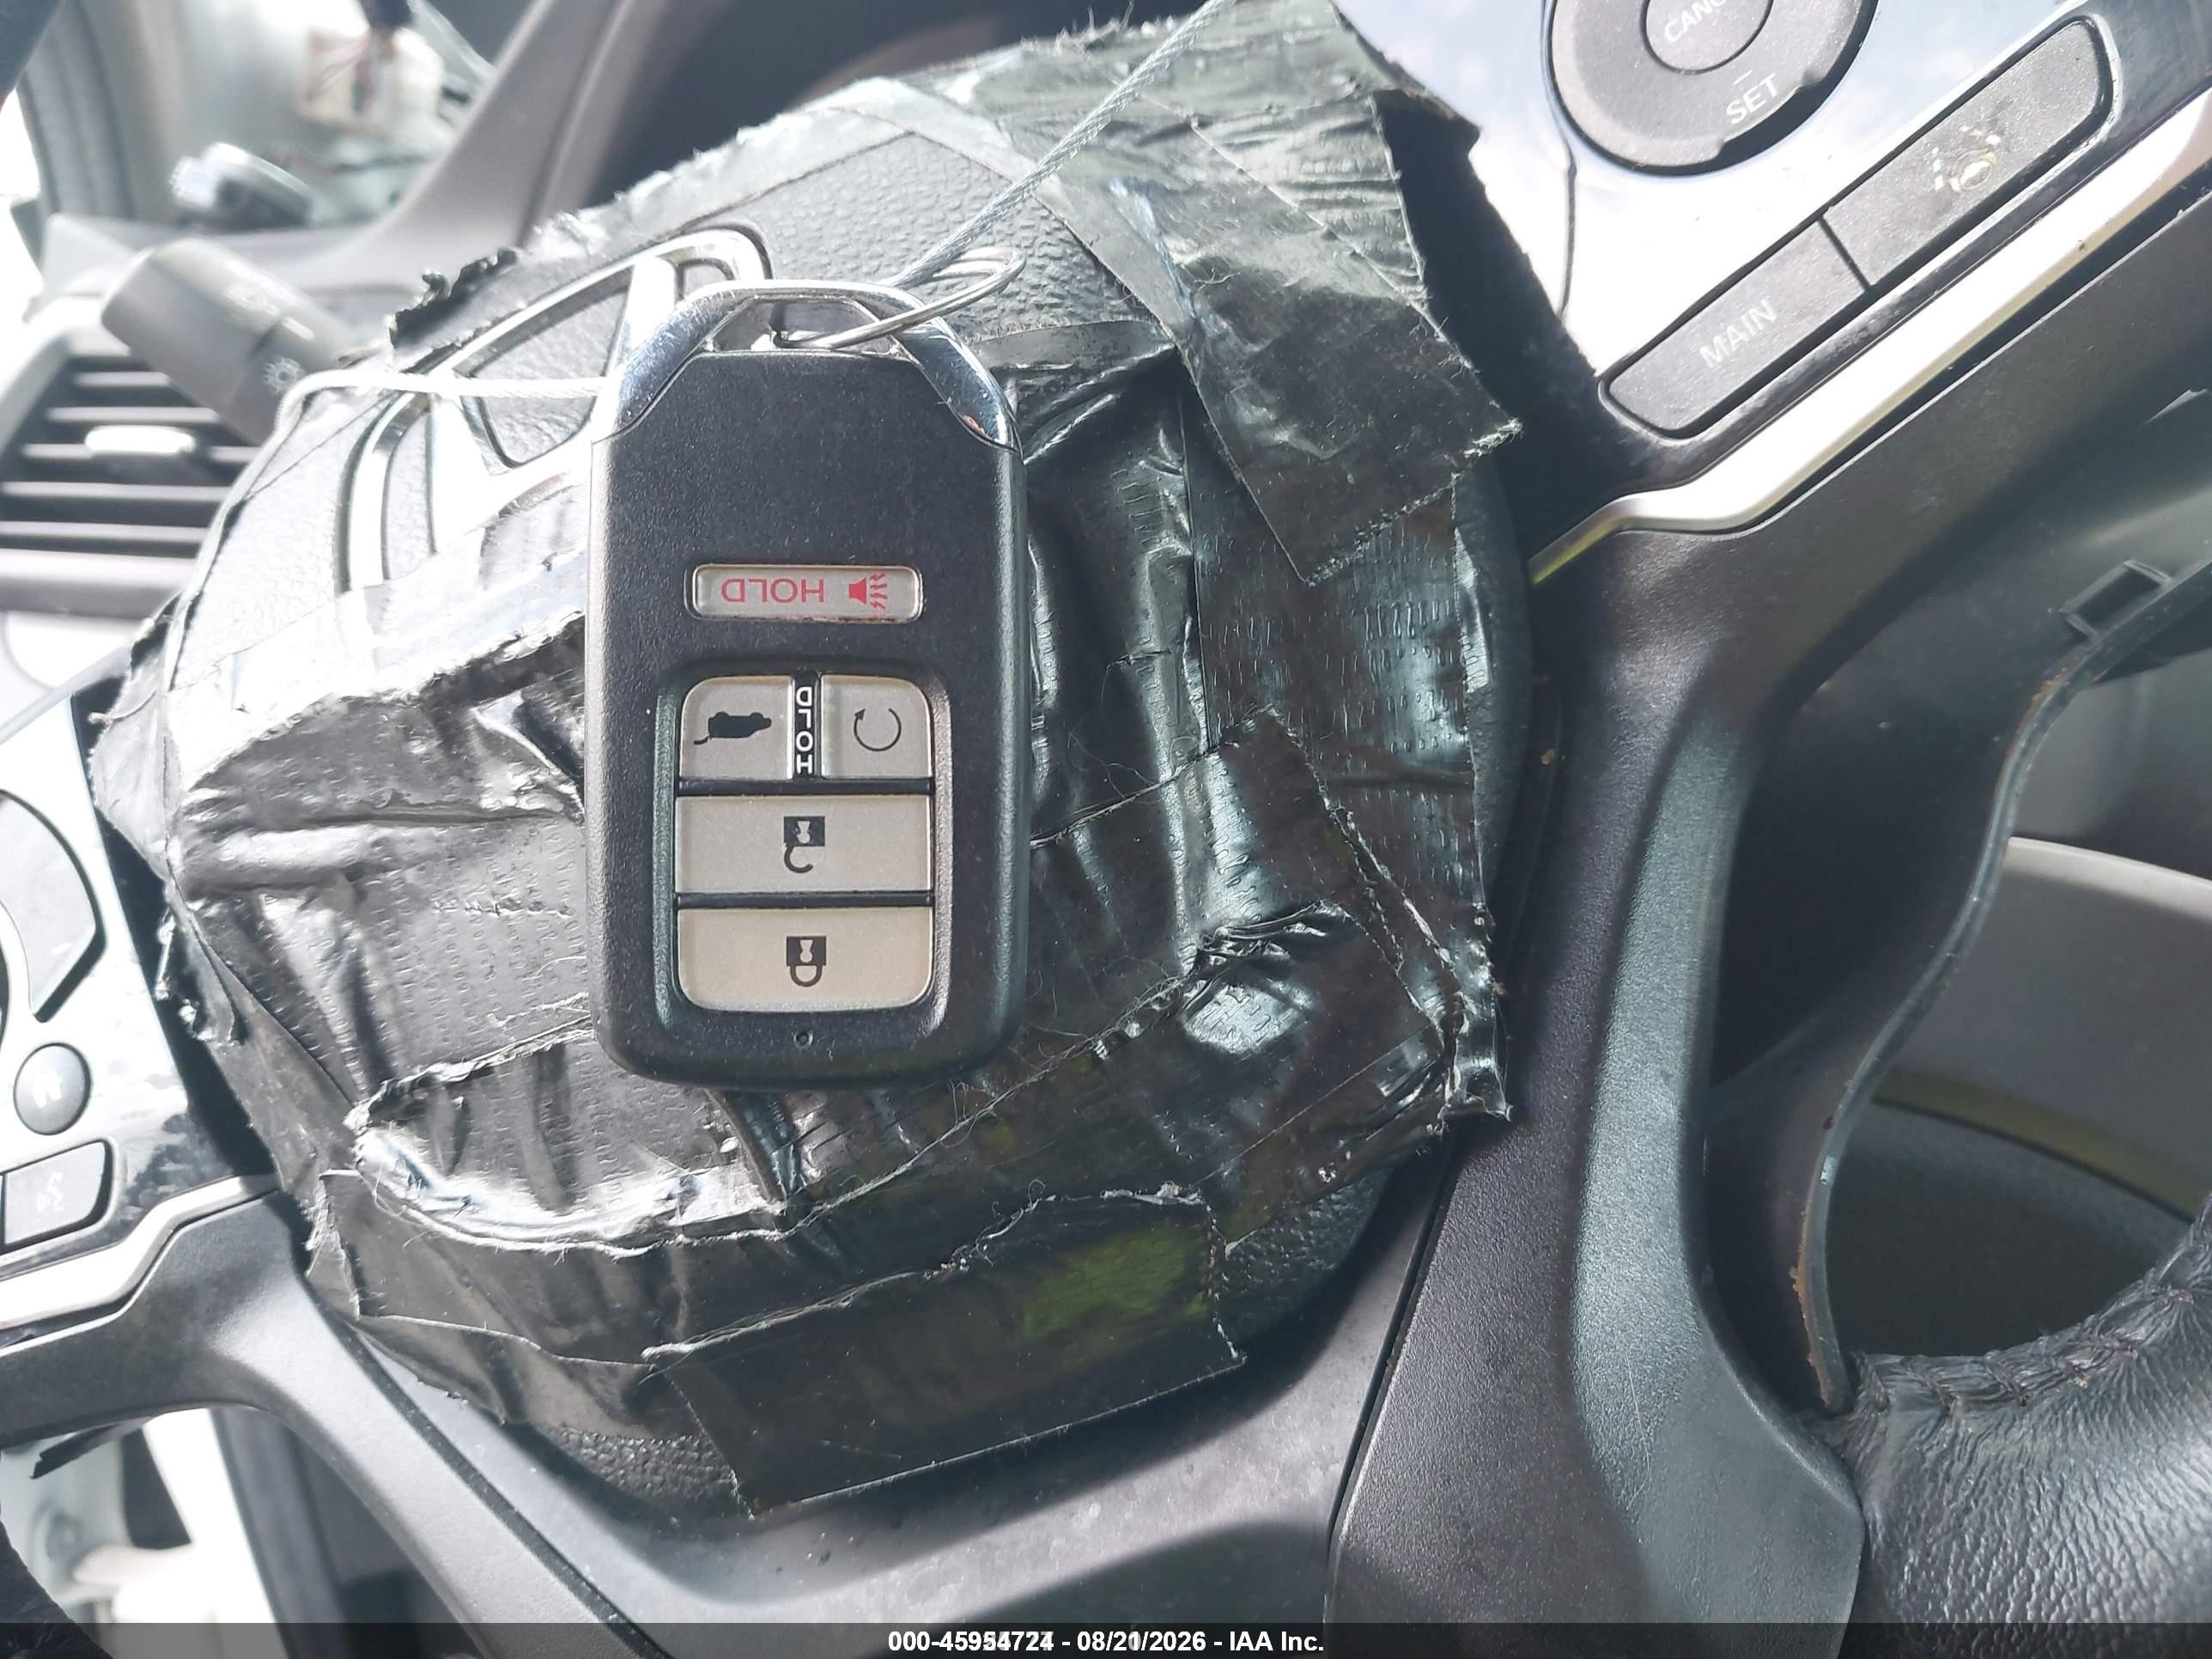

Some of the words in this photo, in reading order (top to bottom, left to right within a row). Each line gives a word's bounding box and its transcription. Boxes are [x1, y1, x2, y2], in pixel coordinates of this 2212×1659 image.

[1725, 72, 1778, 125] SET
[1698, 297, 1779, 369] MAIN
[720, 577, 825, 604] HOLD
[795, 685, 814, 775] HOLD
